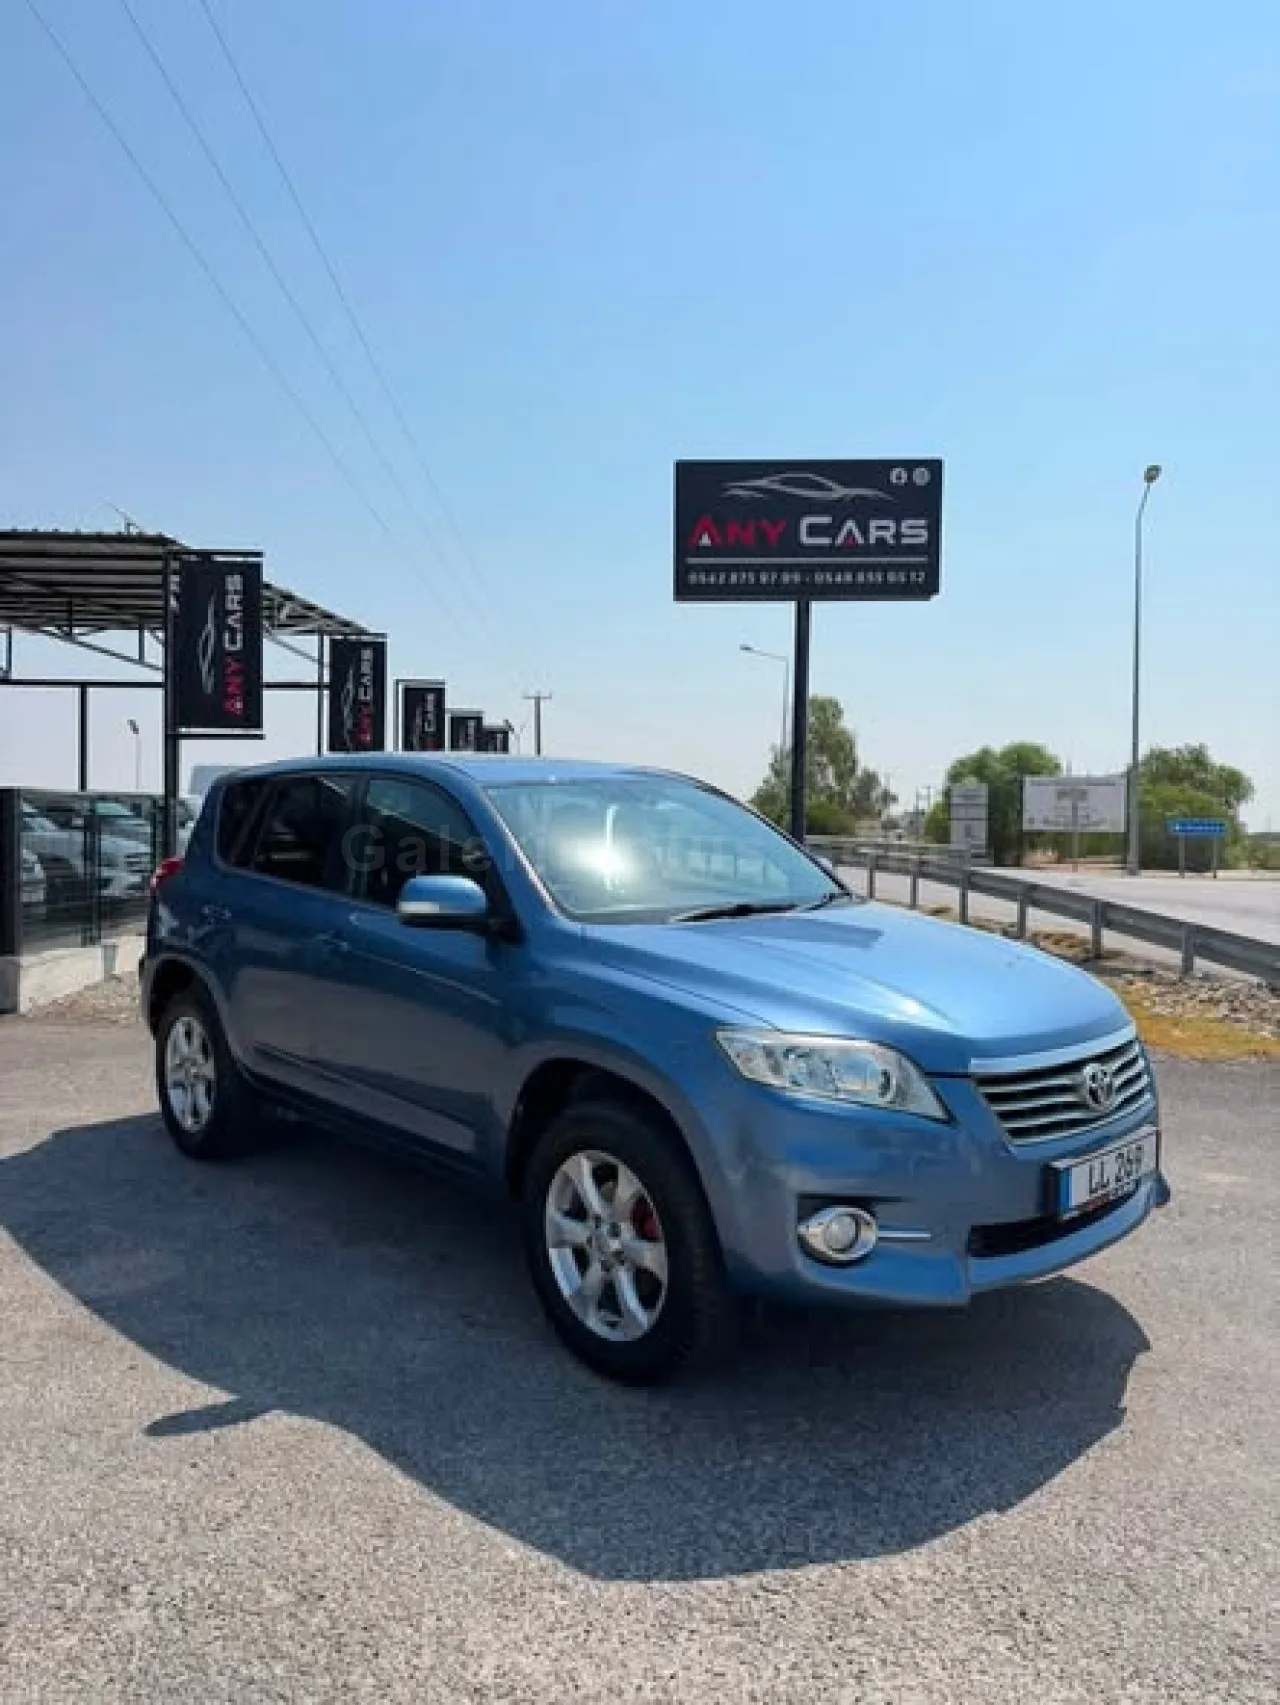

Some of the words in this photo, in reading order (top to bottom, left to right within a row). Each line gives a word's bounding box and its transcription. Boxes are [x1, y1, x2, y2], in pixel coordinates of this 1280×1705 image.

[688, 515, 788, 547] ANY
[799, 516, 929, 546] CARS
[221, 573, 244, 651] CARS
